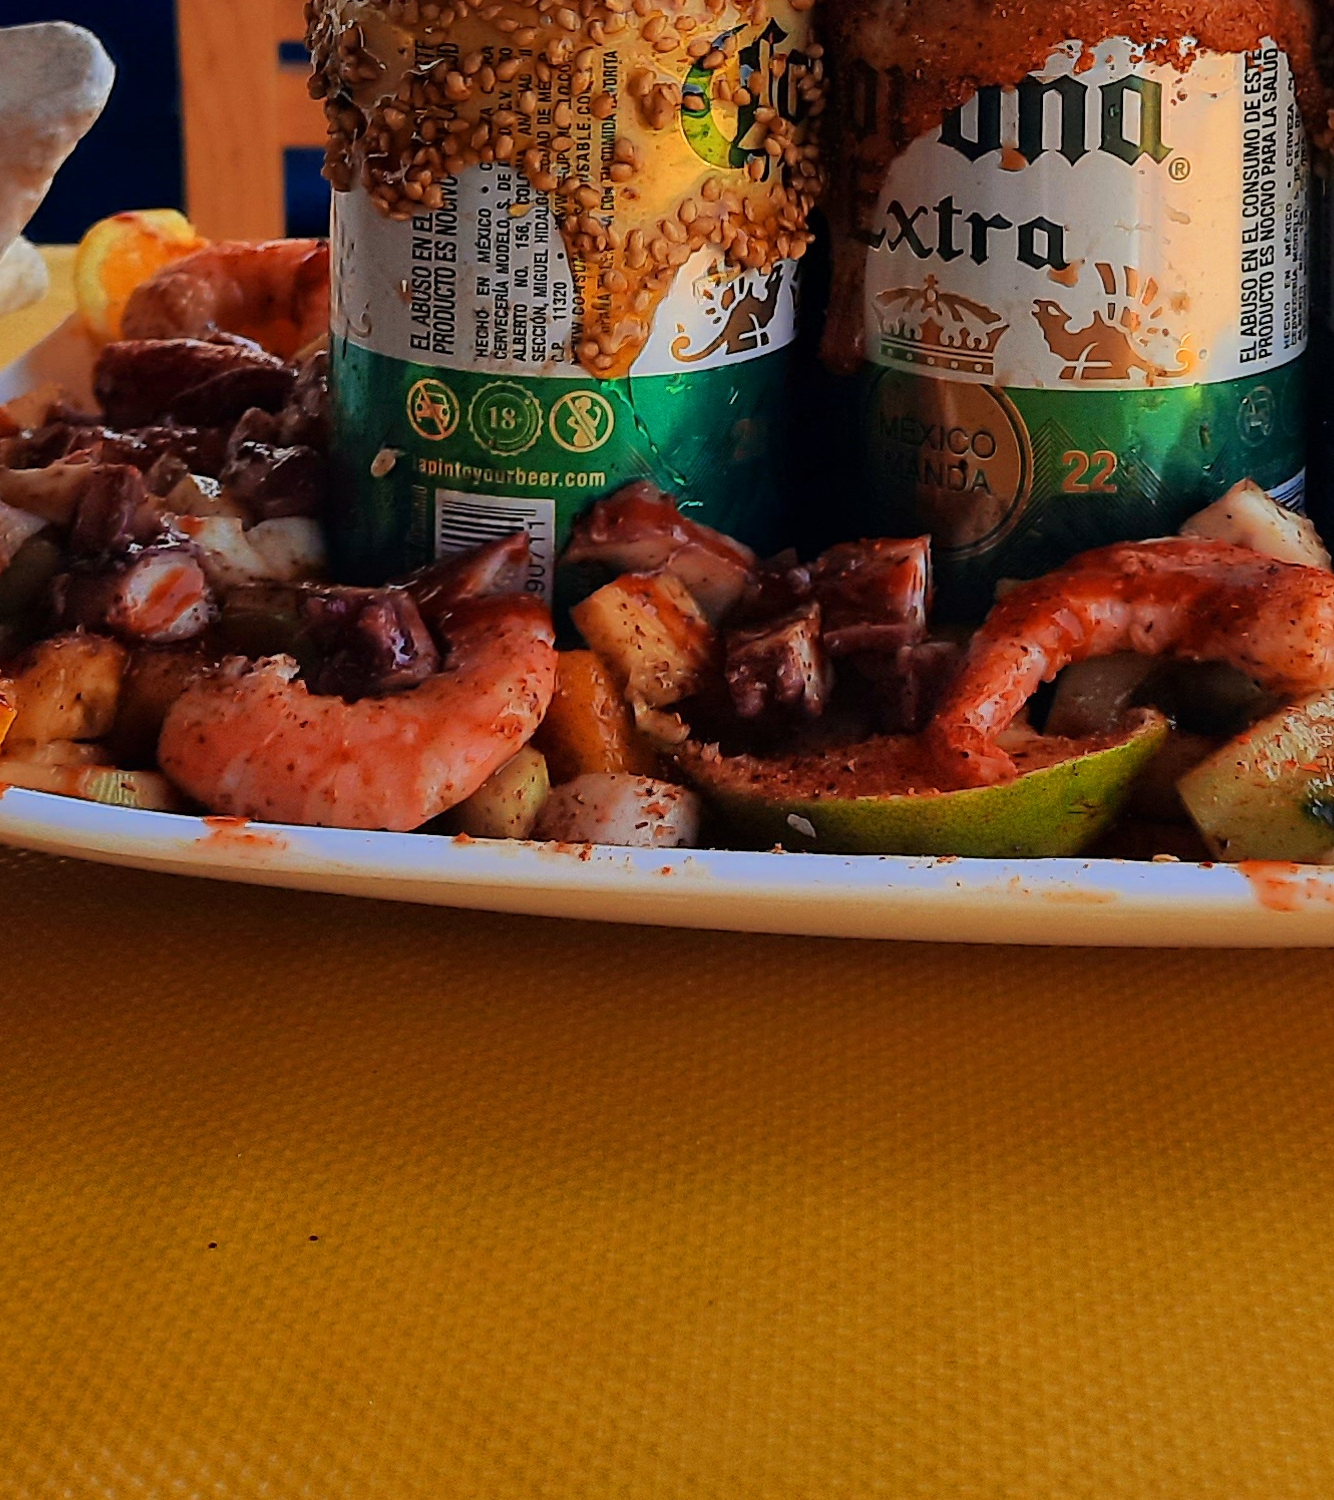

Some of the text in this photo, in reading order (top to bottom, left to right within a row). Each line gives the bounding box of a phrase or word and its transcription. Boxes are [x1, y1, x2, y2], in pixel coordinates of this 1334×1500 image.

[537, 109, 552, 125] DE
[497, 173, 512, 191] DE
[1258, 48, 1278, 359] PRODUCTO ES NOCIVO PARA LA SALUD
[412, 212, 433, 233] EL
[496, 198, 511, 211] S.
[1239, 49, 1263, 364] EL ABUSO EN EL CONSUMO DE ESTE
[412, 236, 433, 262] EN
[435, 241, 457, 263] ES
[475, 208, 492, 264] MÉXICO
[495, 216, 512, 274] MODELO,
[515, 220, 532, 250] 156,
[855, 196, 1073, 271] xtra
[476, 276, 490, 296] EN
[514, 265, 529, 288] NO.
[533, 248, 549, 298] MIGUEL
[411, 266, 433, 328] ABUSO
[433, 266, 456, 356] PRODUCTO
[552, 281, 567, 321] 11320
[410, 331, 431, 352] EL
[475, 309, 490, 359] HECHO
[491, 281, 510, 360] CERVECERÍA
[513, 304, 528, 362] ALBERTO
[530, 303, 550, 363] SECCIÓN,
[887, 454, 994, 496] ANDA
[1061, 450, 1119, 494] 22
